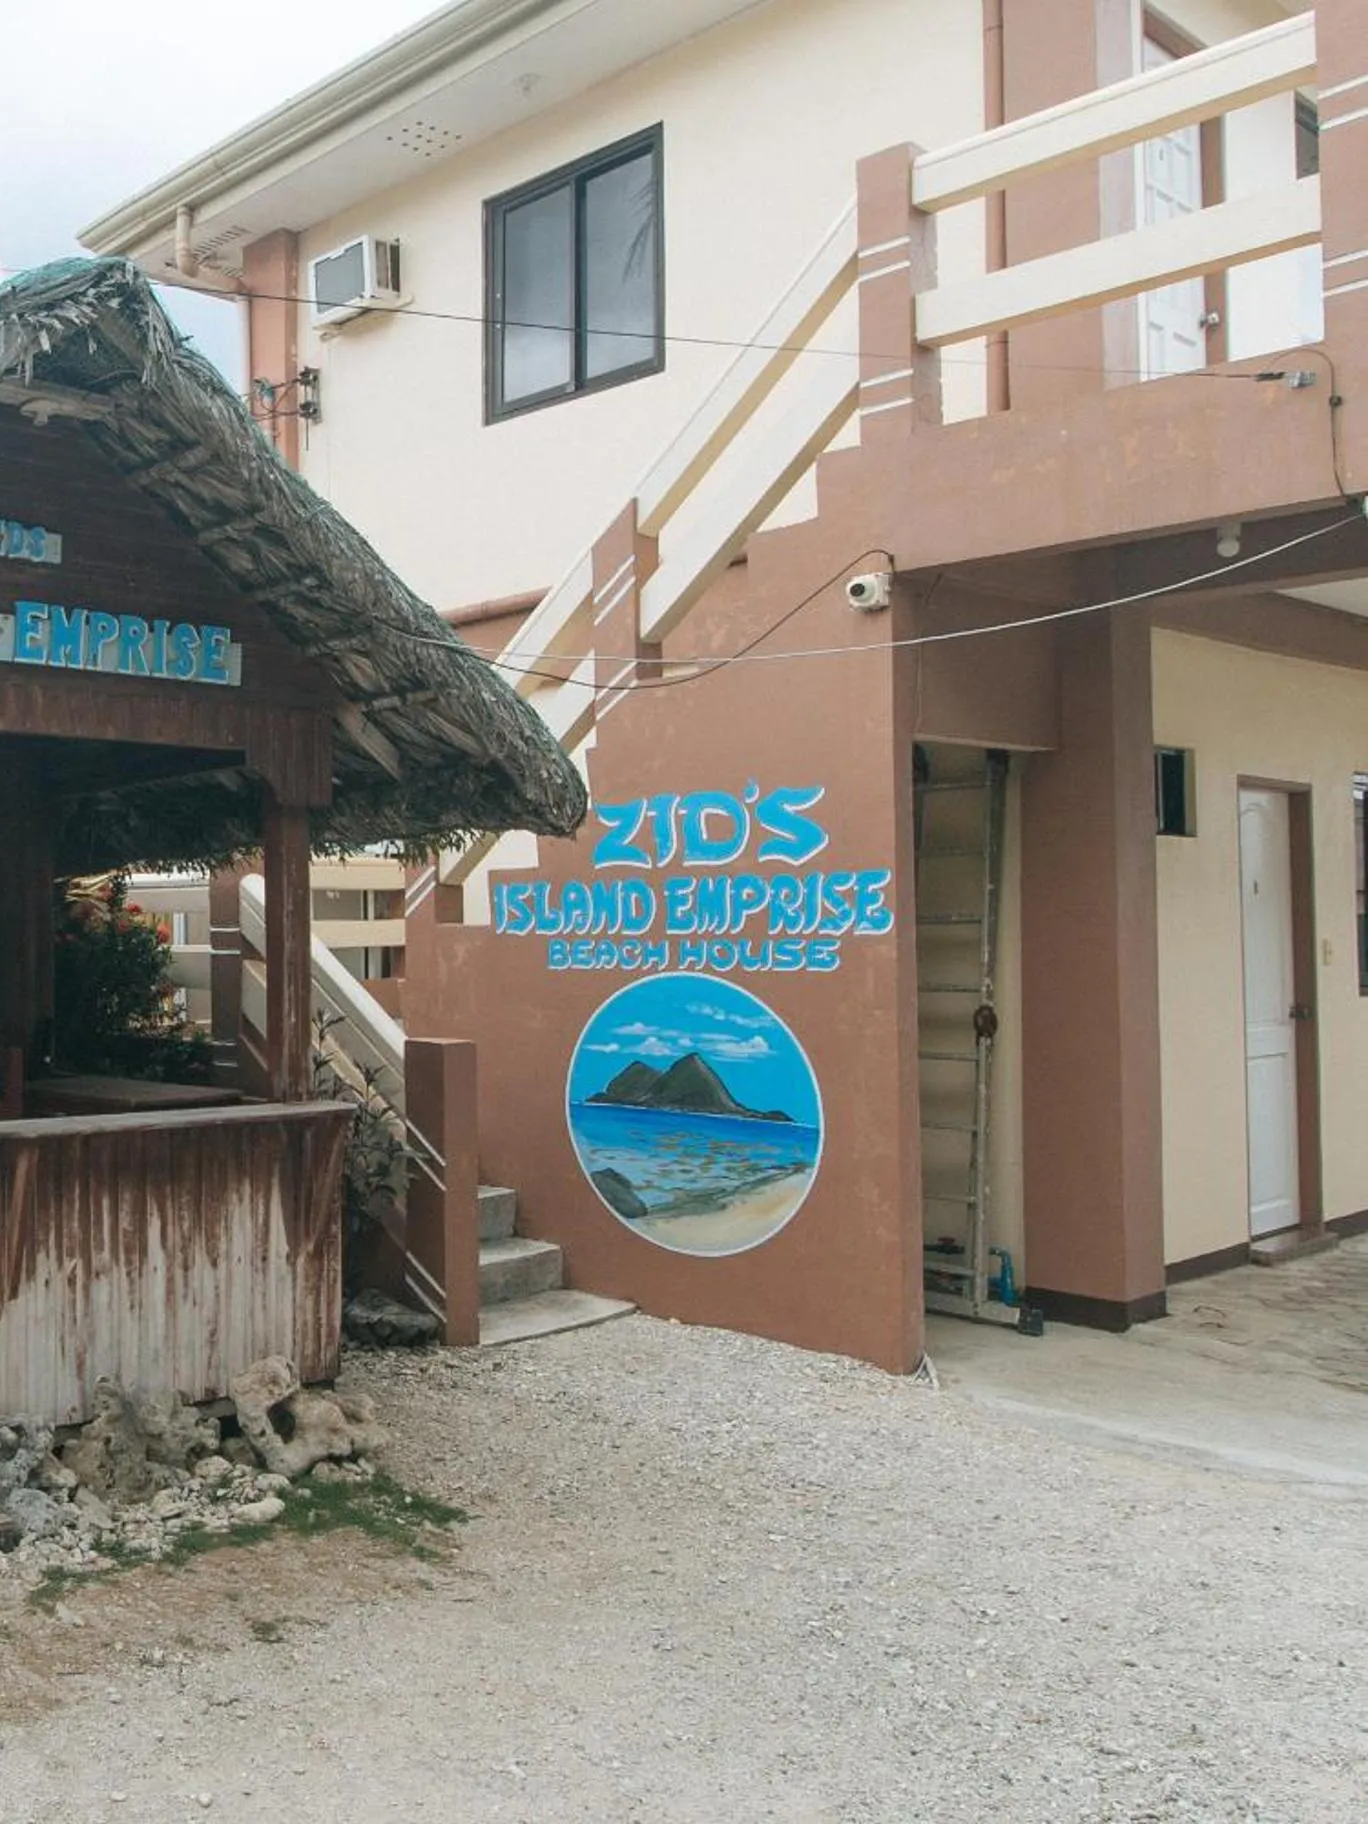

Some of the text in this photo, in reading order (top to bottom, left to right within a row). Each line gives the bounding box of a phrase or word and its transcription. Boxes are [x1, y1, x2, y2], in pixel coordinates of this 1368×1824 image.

[13, 600, 231, 682] EMPRISE
[591, 776, 829, 870] ZID'S
[493, 868, 895, 936] ISLAND EMPRISE
[546, 937, 840, 973] BEACH HOUSE
